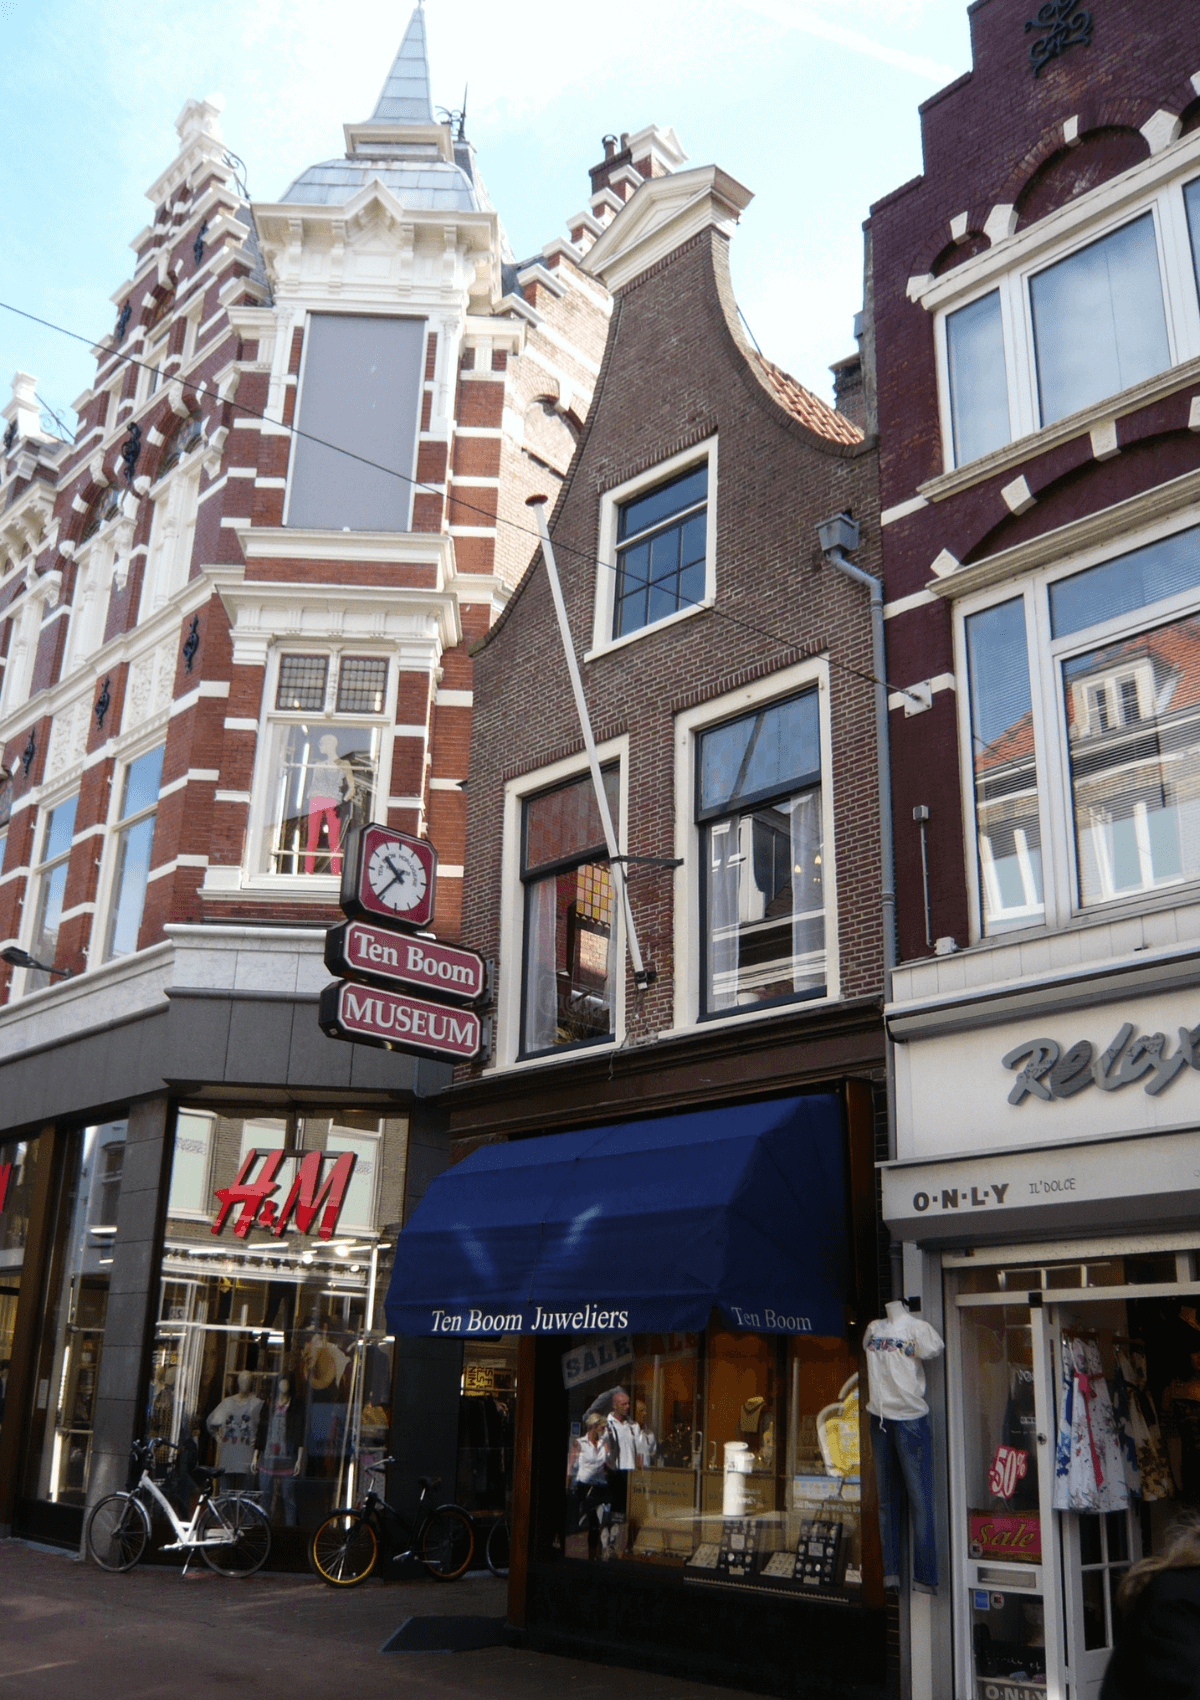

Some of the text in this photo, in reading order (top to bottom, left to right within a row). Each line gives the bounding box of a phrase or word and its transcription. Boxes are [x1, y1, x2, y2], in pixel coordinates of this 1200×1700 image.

[354, 931, 475, 986] Ten Boom
[345, 993, 475, 1047] MUSEUM
[211, 1148, 355, 1240] H&M
[431, 1304, 630, 1331] Ten Boom Juweliers
[730, 1306, 813, 1331] Ten Boom
[566, 1335, 631, 1379] SALE
[989, 1447, 1026, 1497] -50%
[972, 1521, 1038, 1548] Sale
